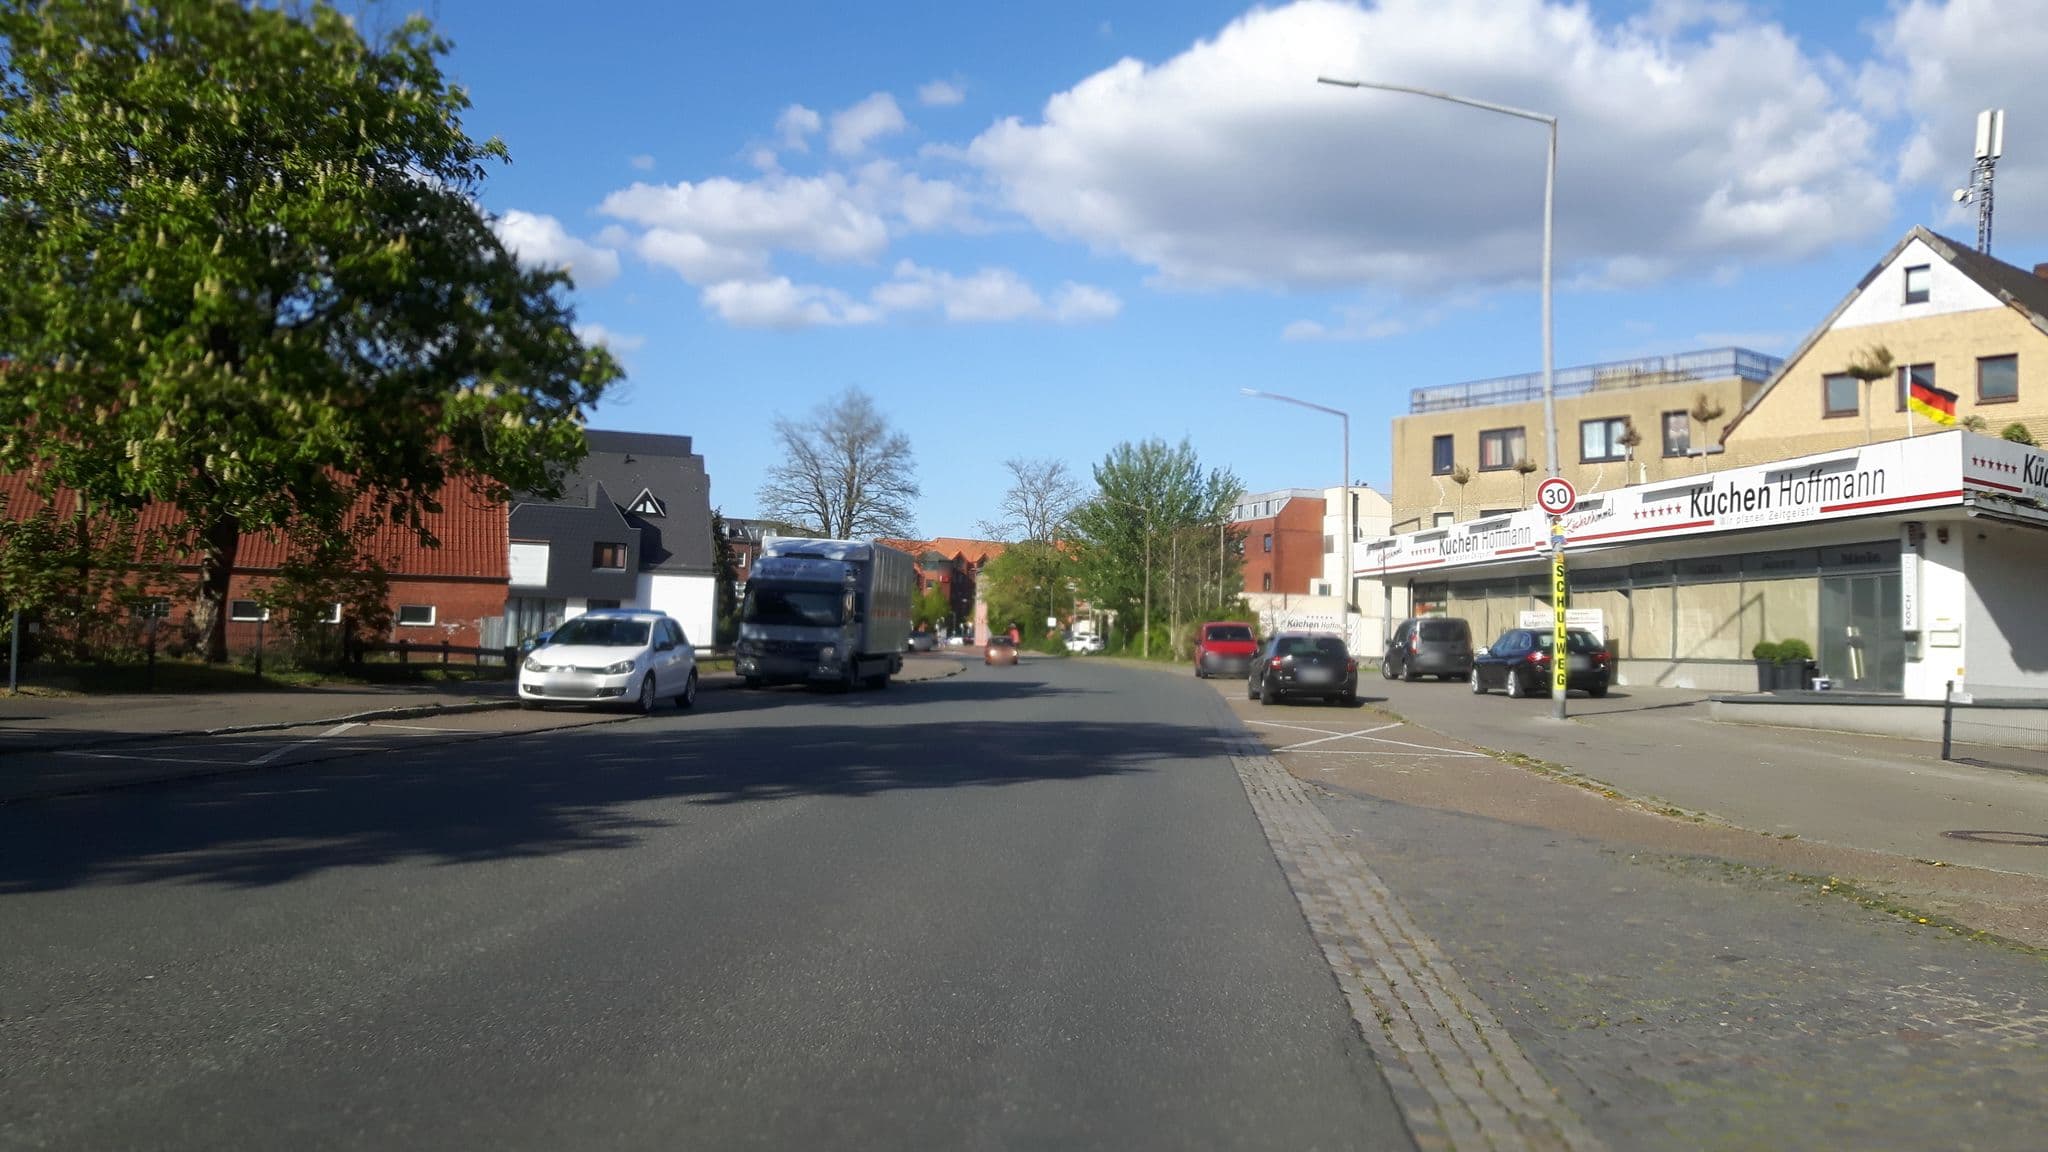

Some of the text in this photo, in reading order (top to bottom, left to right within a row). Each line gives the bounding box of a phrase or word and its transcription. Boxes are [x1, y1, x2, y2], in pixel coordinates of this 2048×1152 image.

[1545, 489, 1567, 505] 30
[1690, 468, 1885, 518] Küchen Hoffmann
[1439, 532, 1478, 556] Küchen
[1482, 525, 1531, 550] Hoffmann
[1286, 619, 1320, 629] Küchen
[1556, 565, 1566, 686] SCHULWEG
